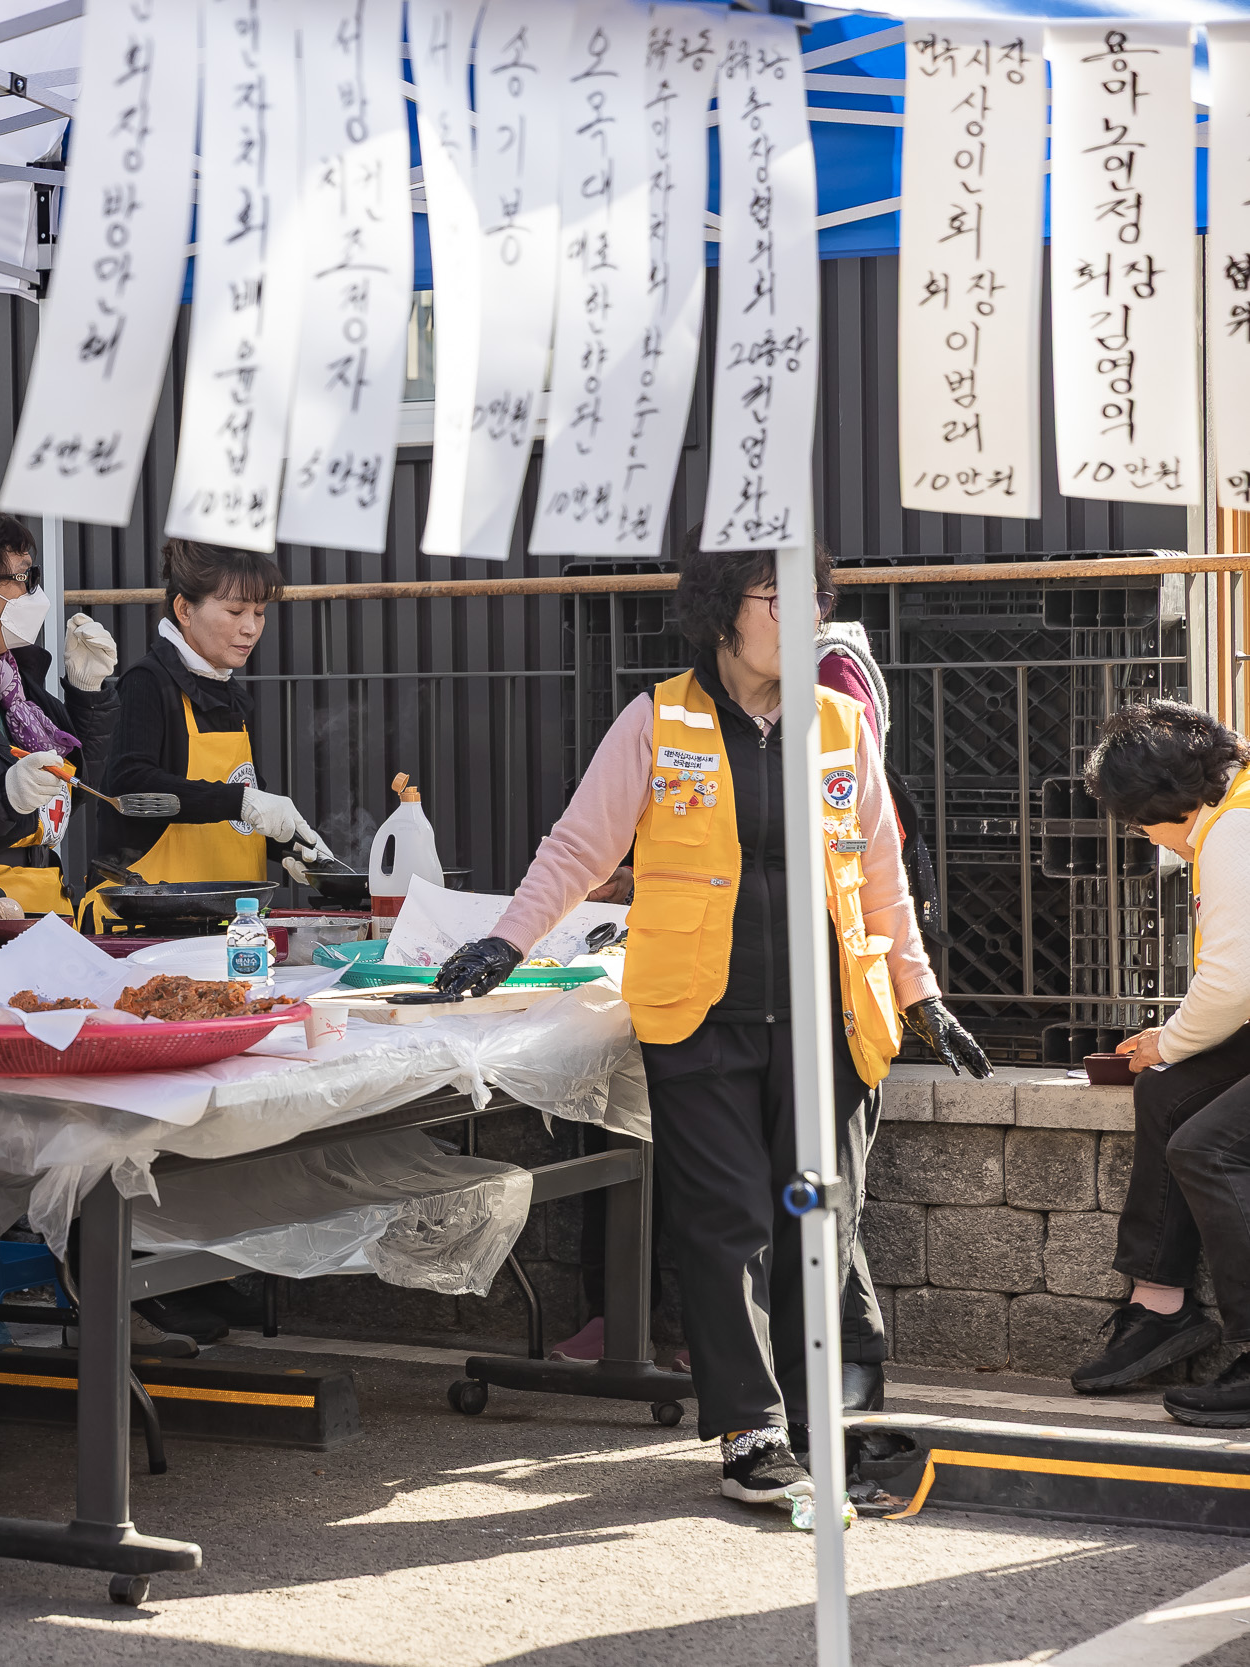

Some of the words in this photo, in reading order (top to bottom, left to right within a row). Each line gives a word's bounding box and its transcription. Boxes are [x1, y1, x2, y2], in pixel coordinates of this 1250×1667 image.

[938, 85, 991, 260] 상인회
[919, 270, 1006, 316] 회장
[1073, 252, 1166, 299] 회장
[942, 321, 983, 452] 이범래
[914, 465, 1016, 496] 10만원
[235, 958, 257, 967] 백산수
